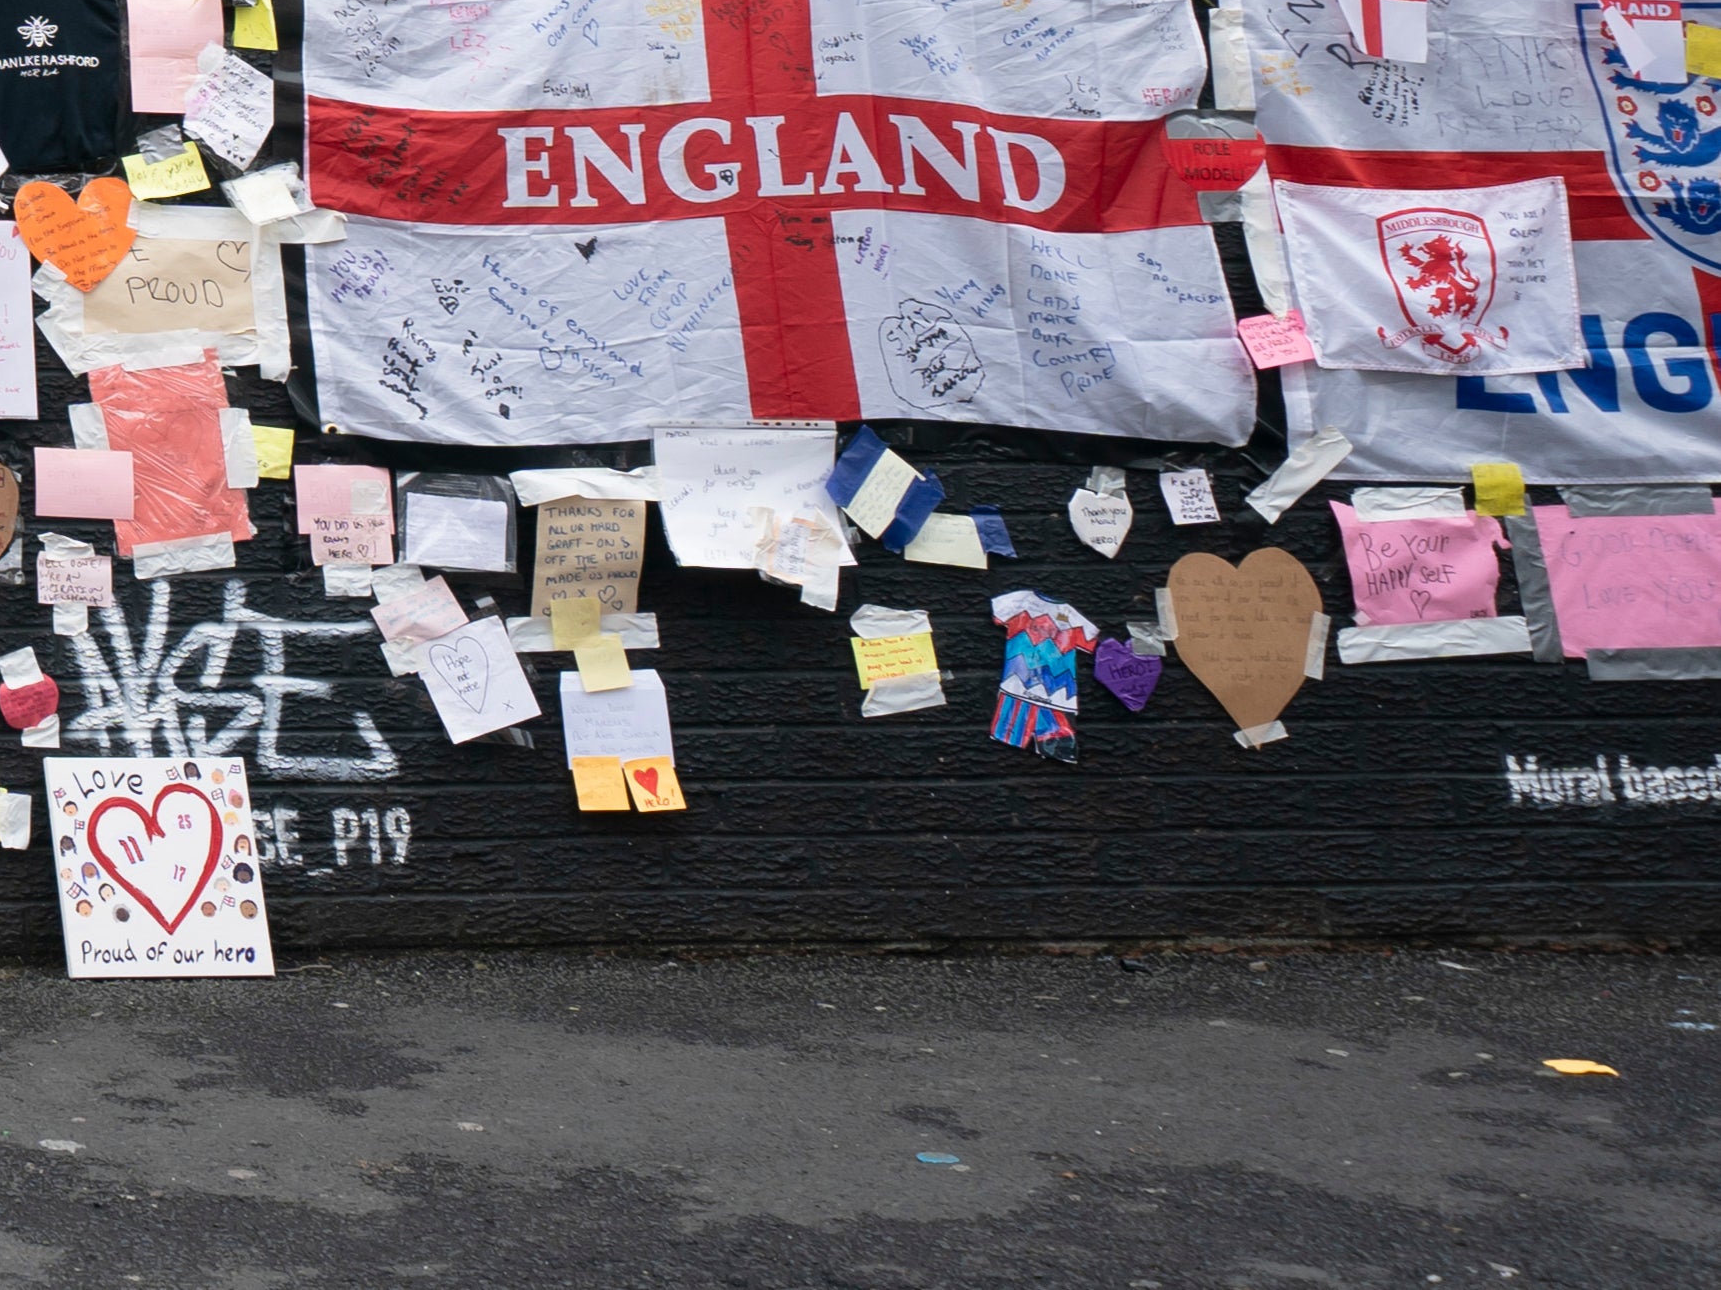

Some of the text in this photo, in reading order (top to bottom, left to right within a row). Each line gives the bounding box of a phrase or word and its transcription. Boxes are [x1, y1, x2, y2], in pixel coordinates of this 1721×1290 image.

[42, 55, 100, 68] RASHFORD
[1193, 140, 1232, 157] ROLE
[497, 111, 1066, 213] ENGLAND
[1183, 166, 1247, 183] MODEL!
[1385, 217, 1480, 234] MIDDLESBROUGH
[126, 276, 224, 308] PROUD
[544, 507, 635, 518] THANKS FOR
[548, 522, 620, 535] ALL UR HARD
[547, 537, 615, 550] GRAFT ON
[545, 556, 566, 565] OFF
[605, 551, 638, 561] PITCH
[1359, 534, 1398, 572] Be
[546, 572, 582, 585] MADE
[1366, 566, 1413, 596] HAPPY
[443, 654, 473, 672] Hope
[177, 813, 193, 831] 25
[81, 940, 256, 965] Proud of our hero
